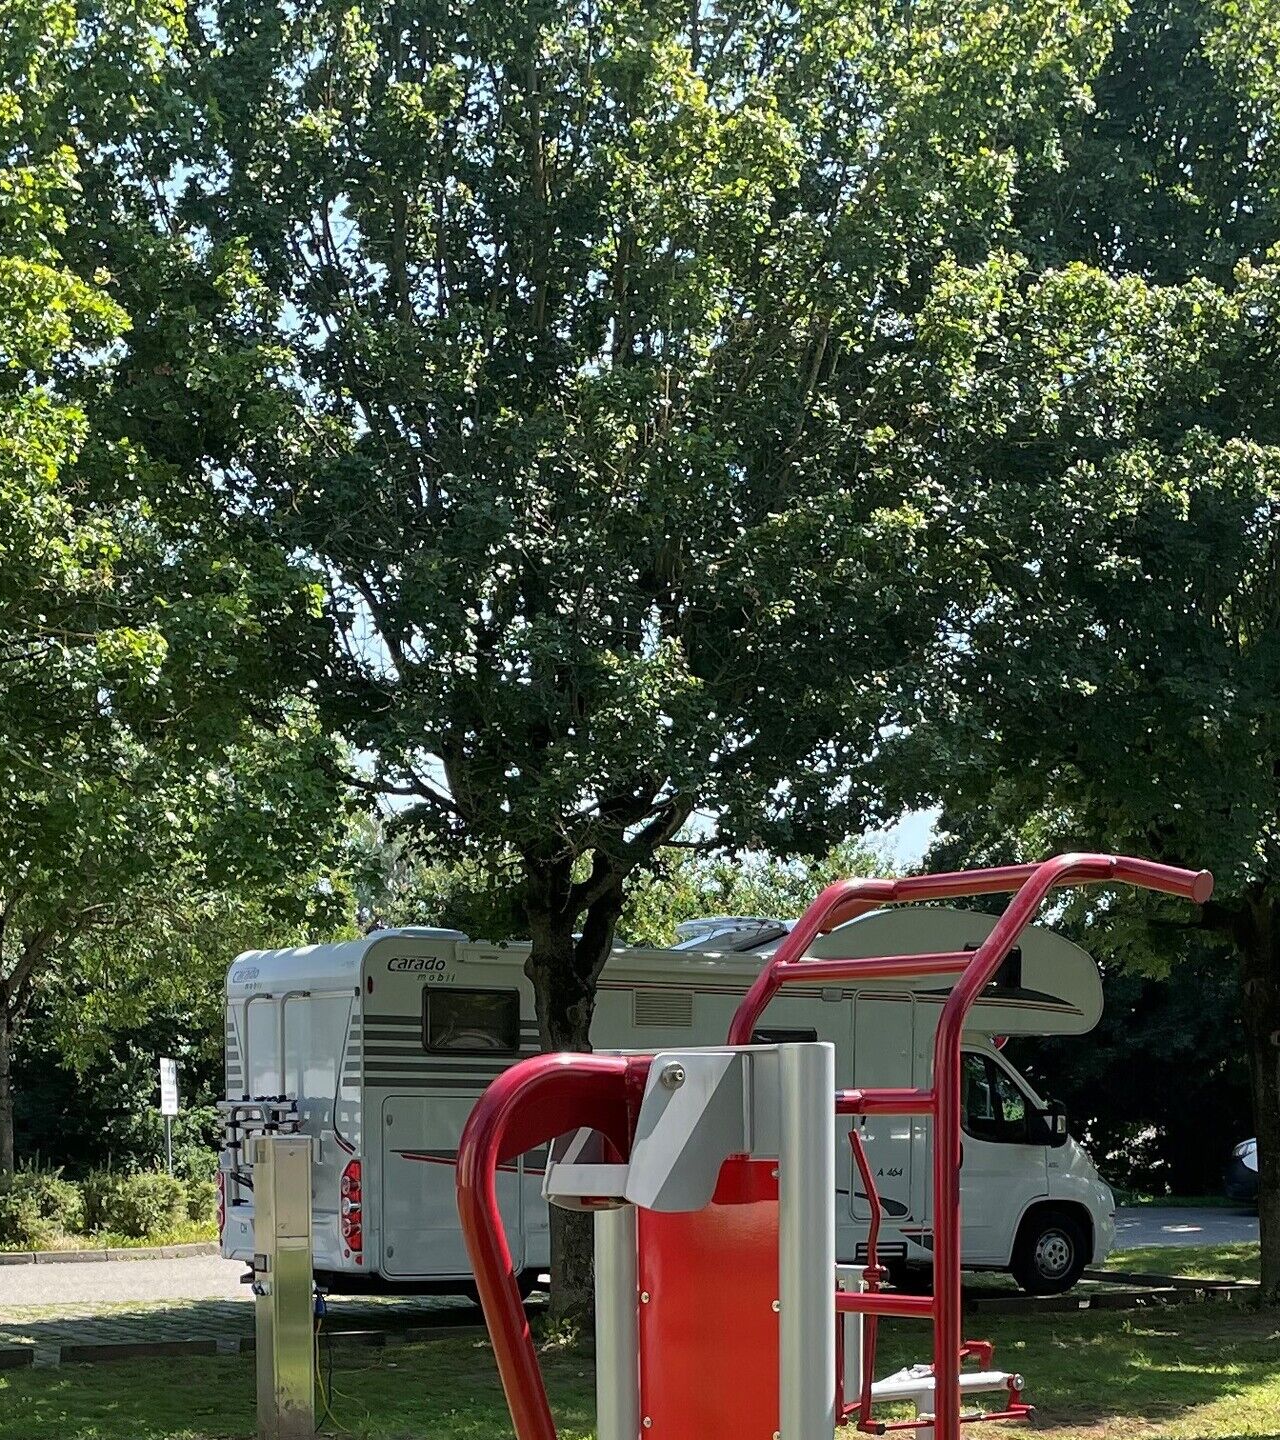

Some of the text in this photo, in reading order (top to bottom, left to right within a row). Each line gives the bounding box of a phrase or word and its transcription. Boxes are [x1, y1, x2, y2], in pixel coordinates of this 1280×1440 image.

[387, 956, 446, 972] Carado
[417, 973, 455, 982] mobil
[877, 1168, 884, 1177] A
